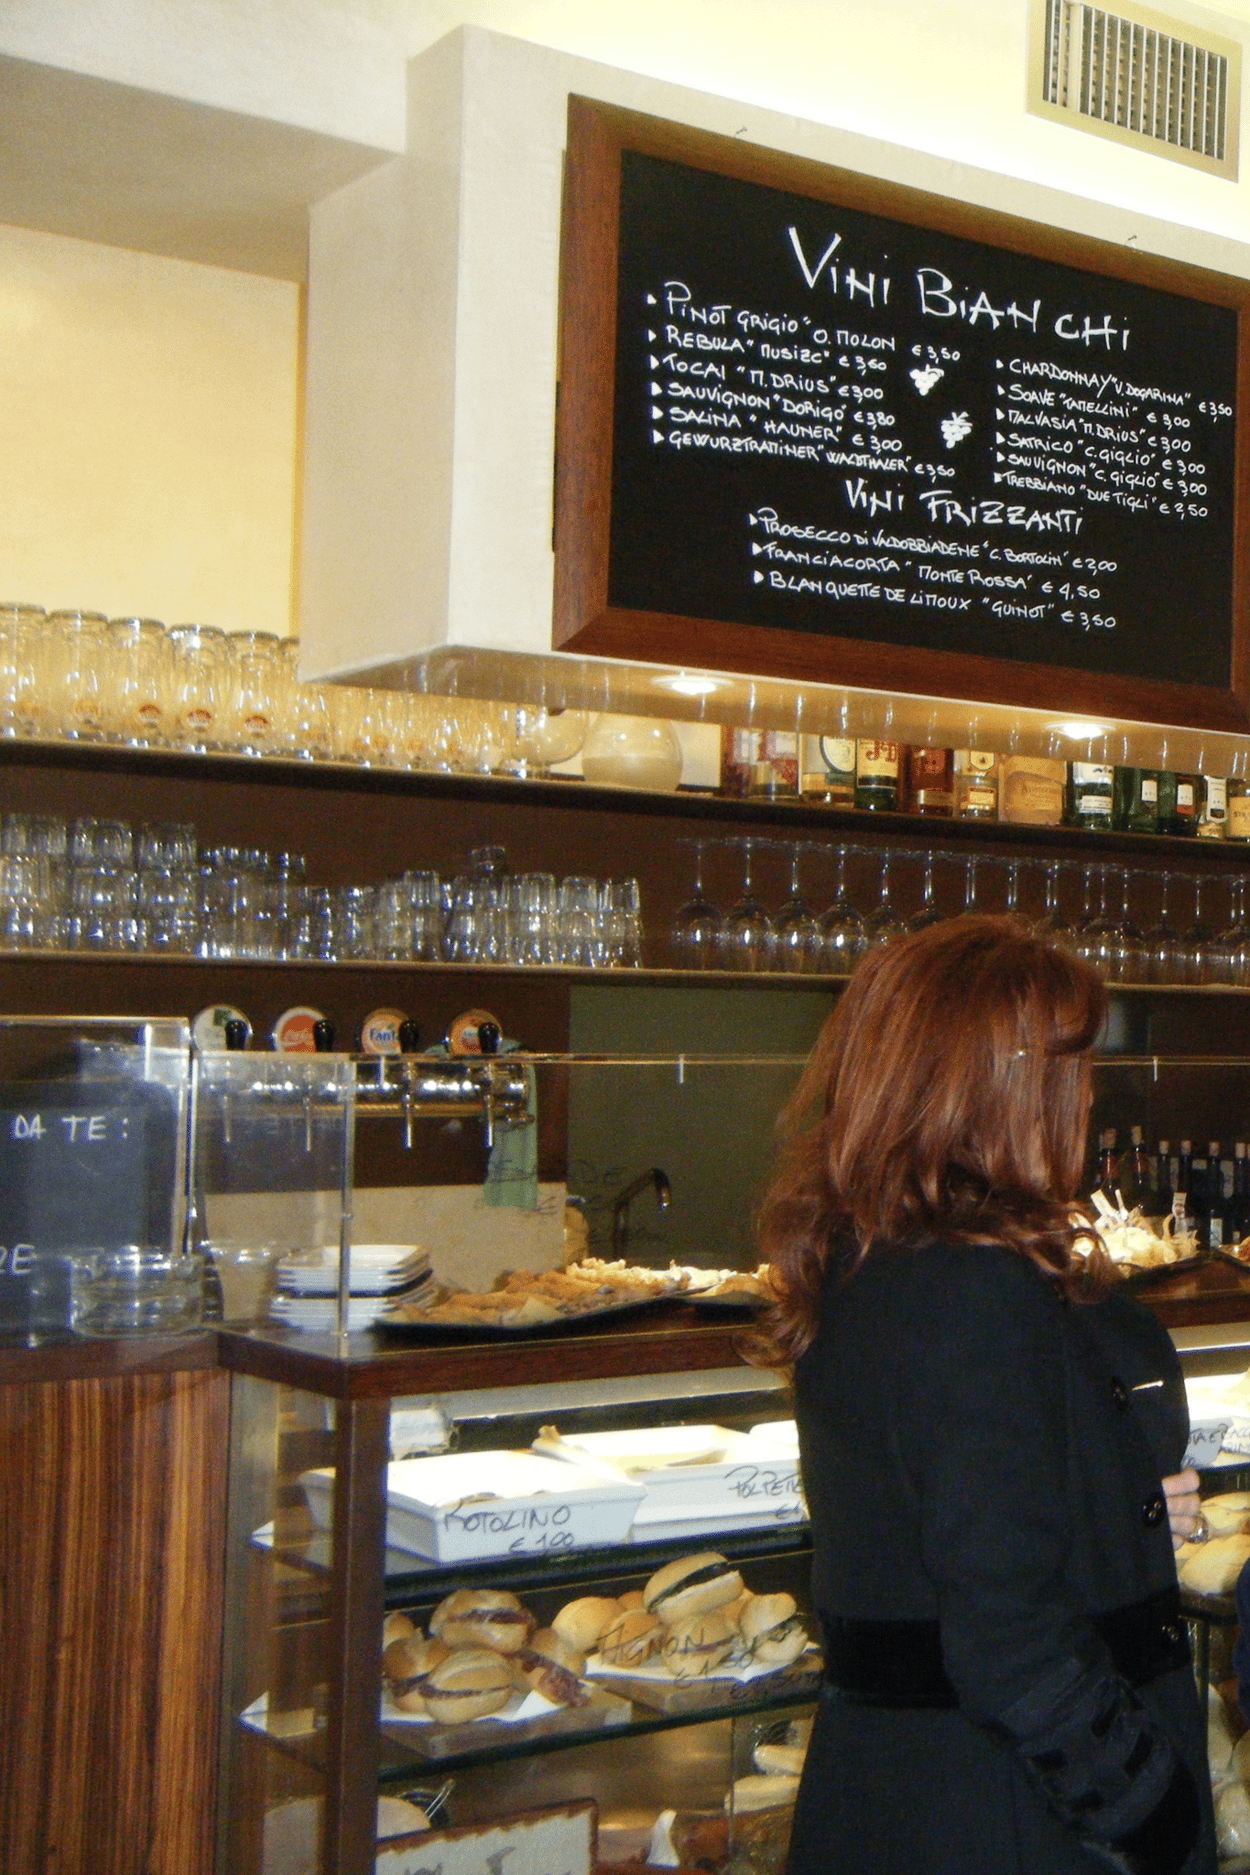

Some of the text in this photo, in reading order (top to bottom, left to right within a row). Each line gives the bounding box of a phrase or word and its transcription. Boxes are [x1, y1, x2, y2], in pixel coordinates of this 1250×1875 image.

[663, 280, 732, 325] PINOT
[736, 309, 799, 336] GRIGIO
[835, 329, 896, 352] MOLON
[911, 344, 922, 357] €
[926, 345, 961, 365] 3,50
[664, 324, 746, 353] REBULA
[838, 354, 851, 368] €
[661, 352, 726, 381] TOCAI
[836, 384, 850, 398] €
[851, 384, 884, 404] 3,00
[1007, 358, 1114, 401] CHARDONNAY
[1198, 401, 1207, 413] €
[1209, 401, 1233, 423] 3,50
[666, 381, 771, 412] SAUVIGNON
[852, 410, 865, 424] €
[865, 411, 896, 431] 3,80
[668, 406, 742, 428] SALINA
[851, 433, 865, 447] €
[869, 434, 903, 456] 3,00
[1007, 383, 1056, 407] SOAVE
[1146, 411, 1158, 424] €
[1162, 413, 1191, 431] 3,00
[1006, 432, 1074, 454] SATRICO
[1161, 458, 1173, 471] €
[1176, 459, 1206, 477] 3,00
[1007, 409, 1078, 433] MALVASIA
[1147, 435, 1158, 447] €
[1160, 436, 1192, 455] 3,00
[914, 463, 925, 475] €
[1004, 453, 1087, 480] SAUVIGNON
[1162, 478, 1174, 490] €
[1176, 479, 1208, 498] 3,00
[918, 486, 1084, 535] FRIZZANTI
[999, 469, 1076, 496] TREBBIANO
[1158, 502, 1171, 514] €
[1173, 502, 1208, 520] 2,50
[756, 506, 852, 544] PROSECCO
[871, 528, 980, 558] VALDOBBIADENE
[1072, 557, 1083, 569] €
[759, 538, 903, 572] FRANCIACORTA
[1041, 580, 1054, 594] €
[1058, 582, 1101, 601] 4,50
[768, 570, 881, 600] BLANQUETTE
[883, 587, 906, 603] DE
[909, 589, 972, 611] LIMOUX
[1060, 610, 1075, 623] €
[1079, 611, 1117, 632] 3,50
